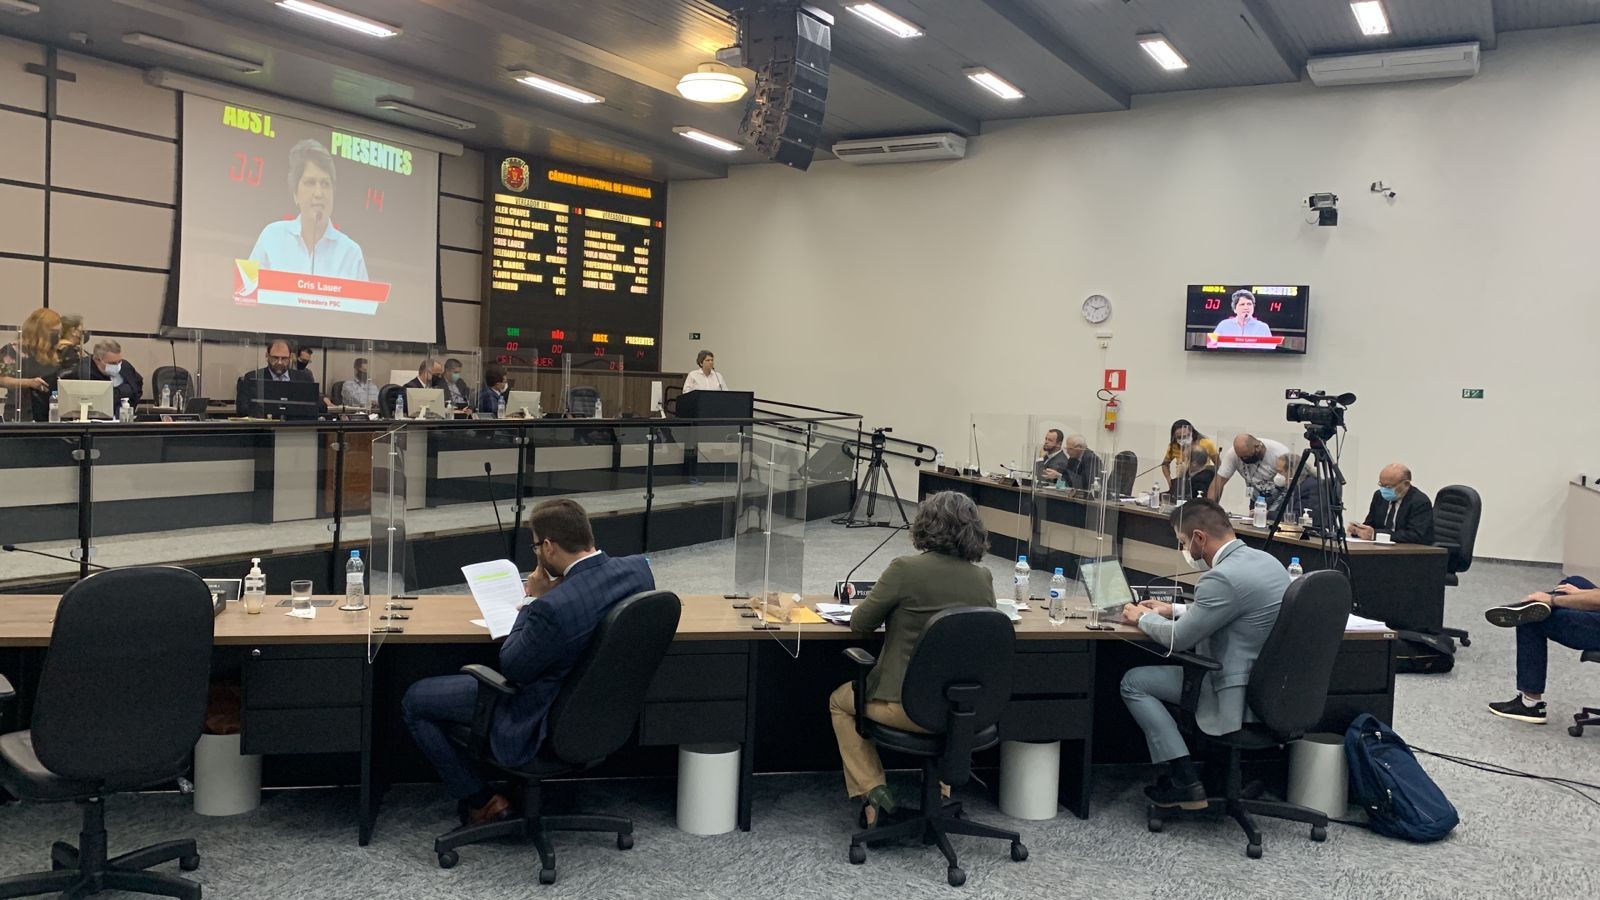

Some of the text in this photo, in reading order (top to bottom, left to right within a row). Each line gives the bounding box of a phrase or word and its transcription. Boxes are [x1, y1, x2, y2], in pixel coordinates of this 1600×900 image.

[331, 131, 413, 176] PRESENTES
[548, 169, 577, 185] CÂMARA
[364, 187, 385, 213] 14
[297, 279, 342, 293] Cris Lauer
[1269, 302, 1282, 312] 14
[506, 327, 520, 337] SIM
[506, 341, 519, 351] 00
[625, 335, 655, 347] PRESENTES
[551, 344, 563, 354] 00
